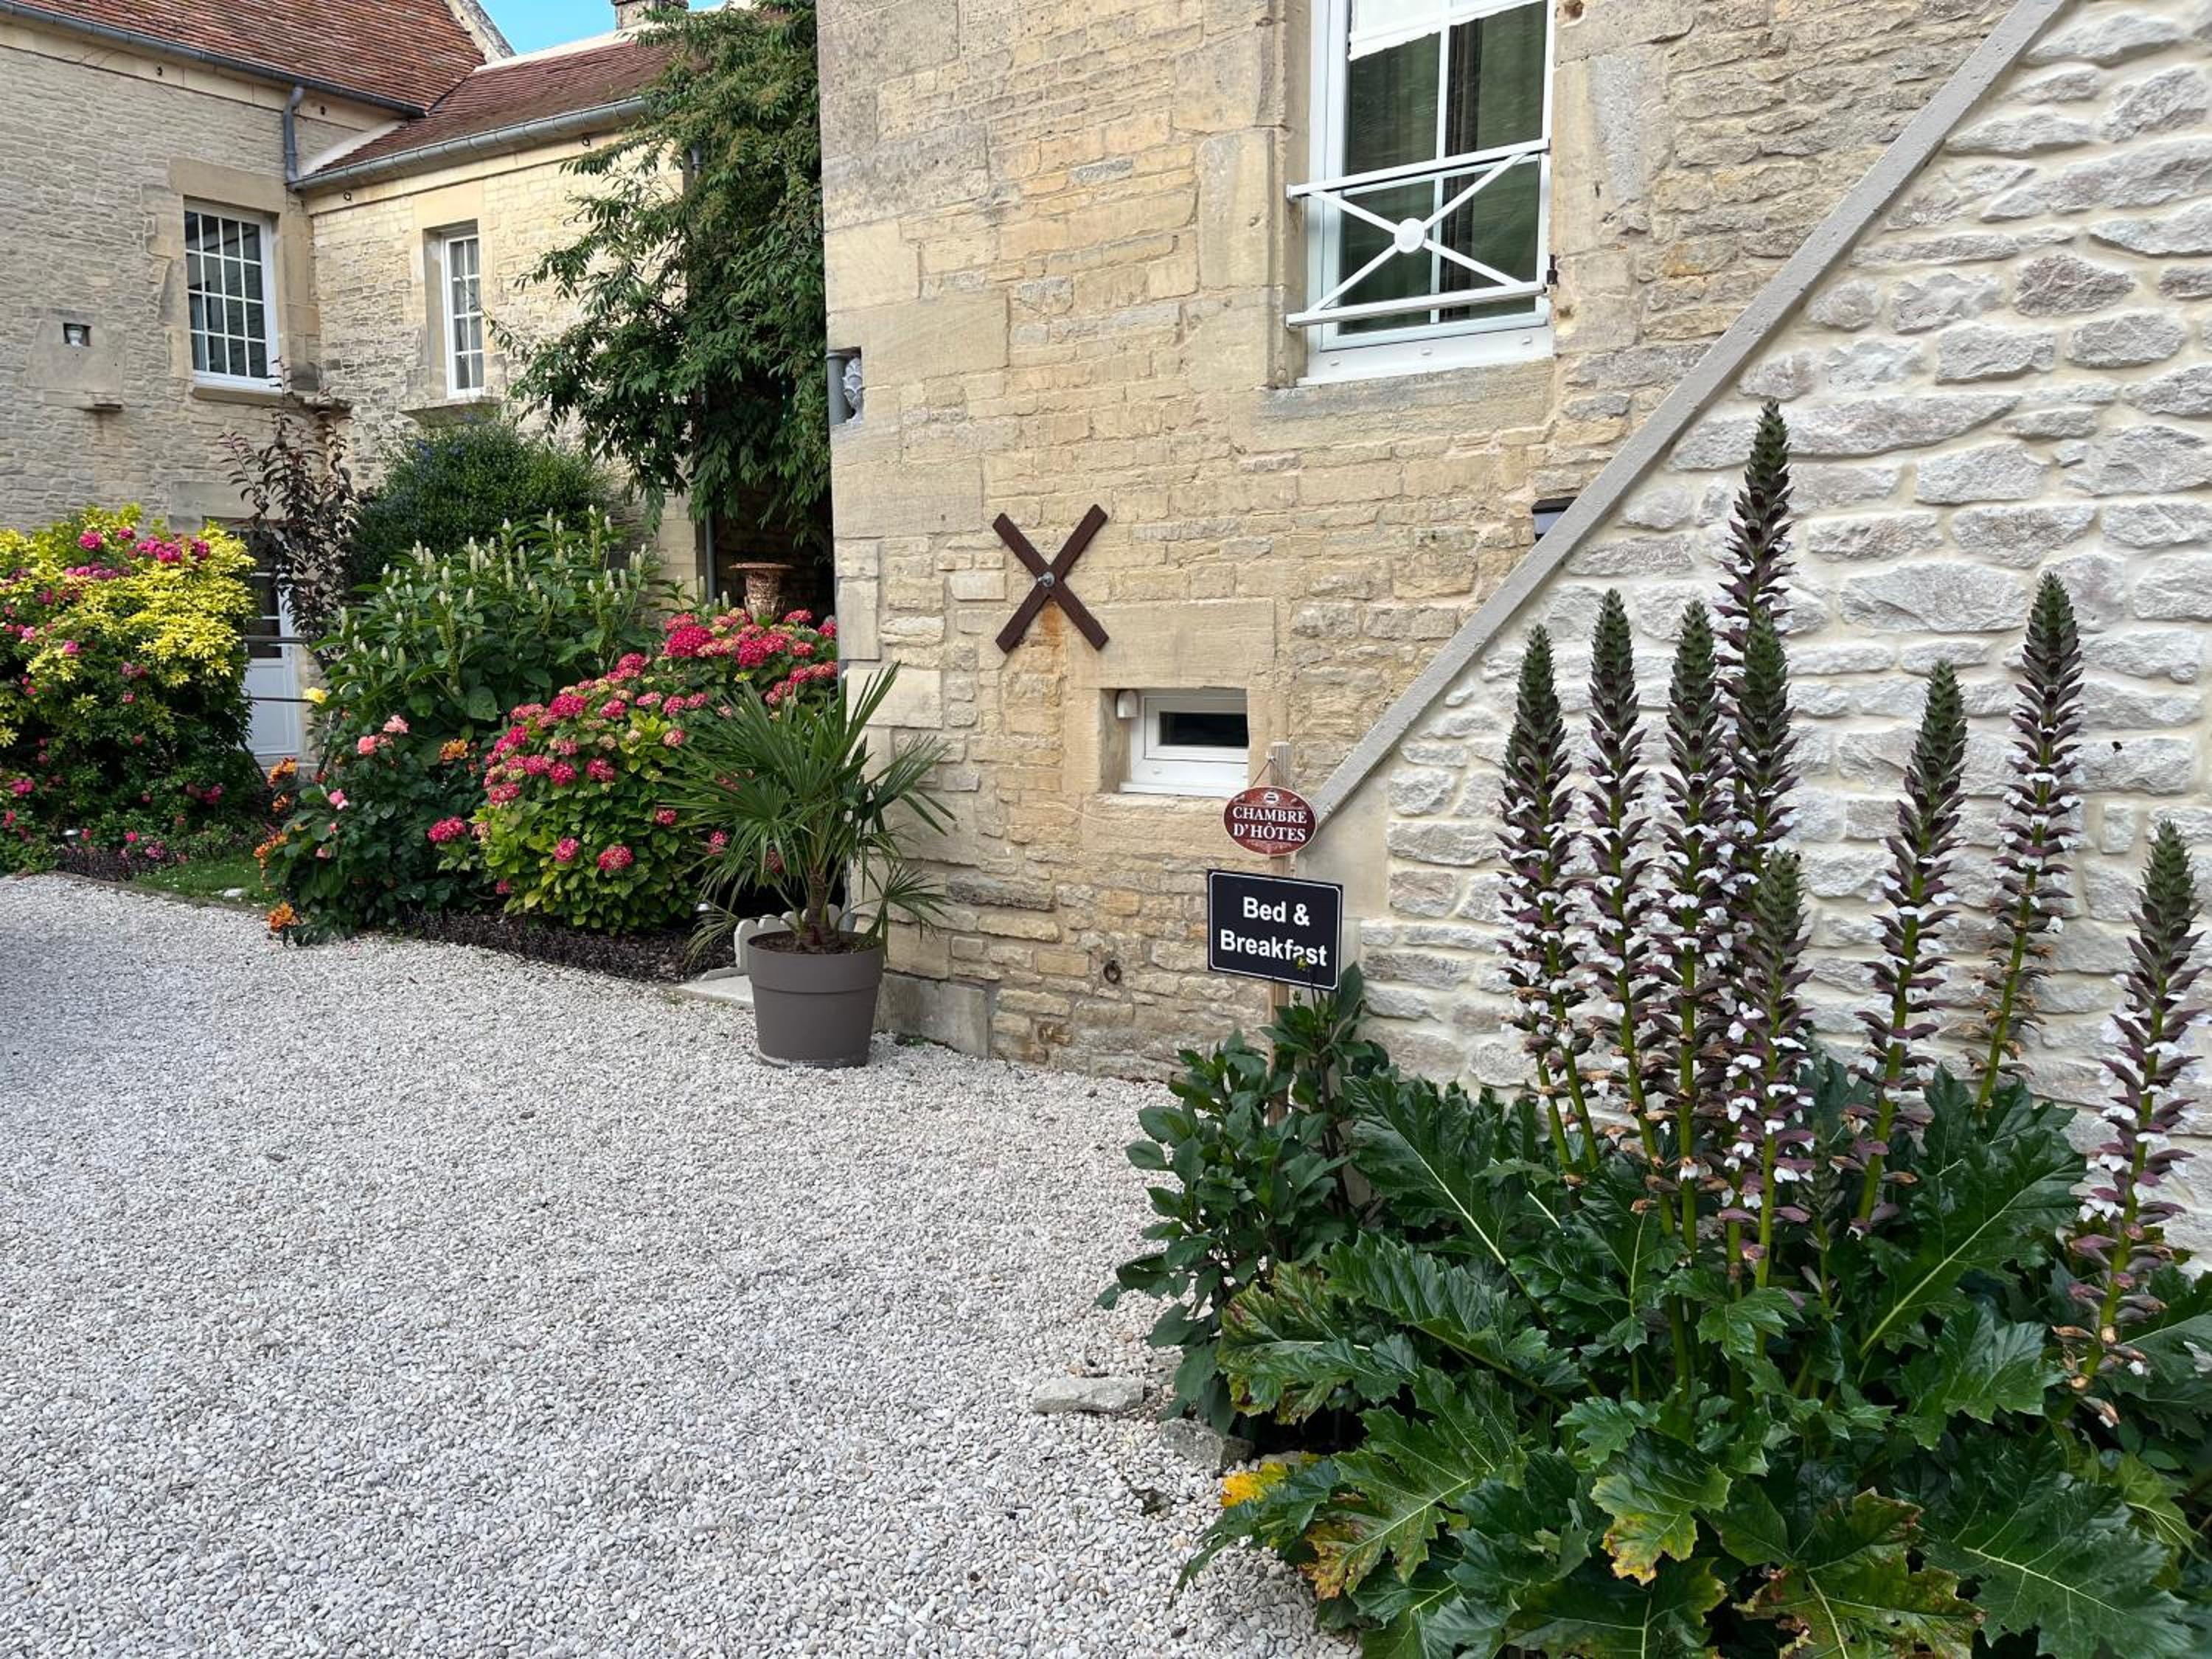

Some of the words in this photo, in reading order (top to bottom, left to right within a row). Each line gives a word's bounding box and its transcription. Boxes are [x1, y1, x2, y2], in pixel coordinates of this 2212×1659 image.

[1232, 806, 1307, 824] CHAMBRE
[1234, 822, 1307, 842] D'HÔTES
[1243, 896, 1287, 922] Bed
[1293, 903, 1310, 926] &
